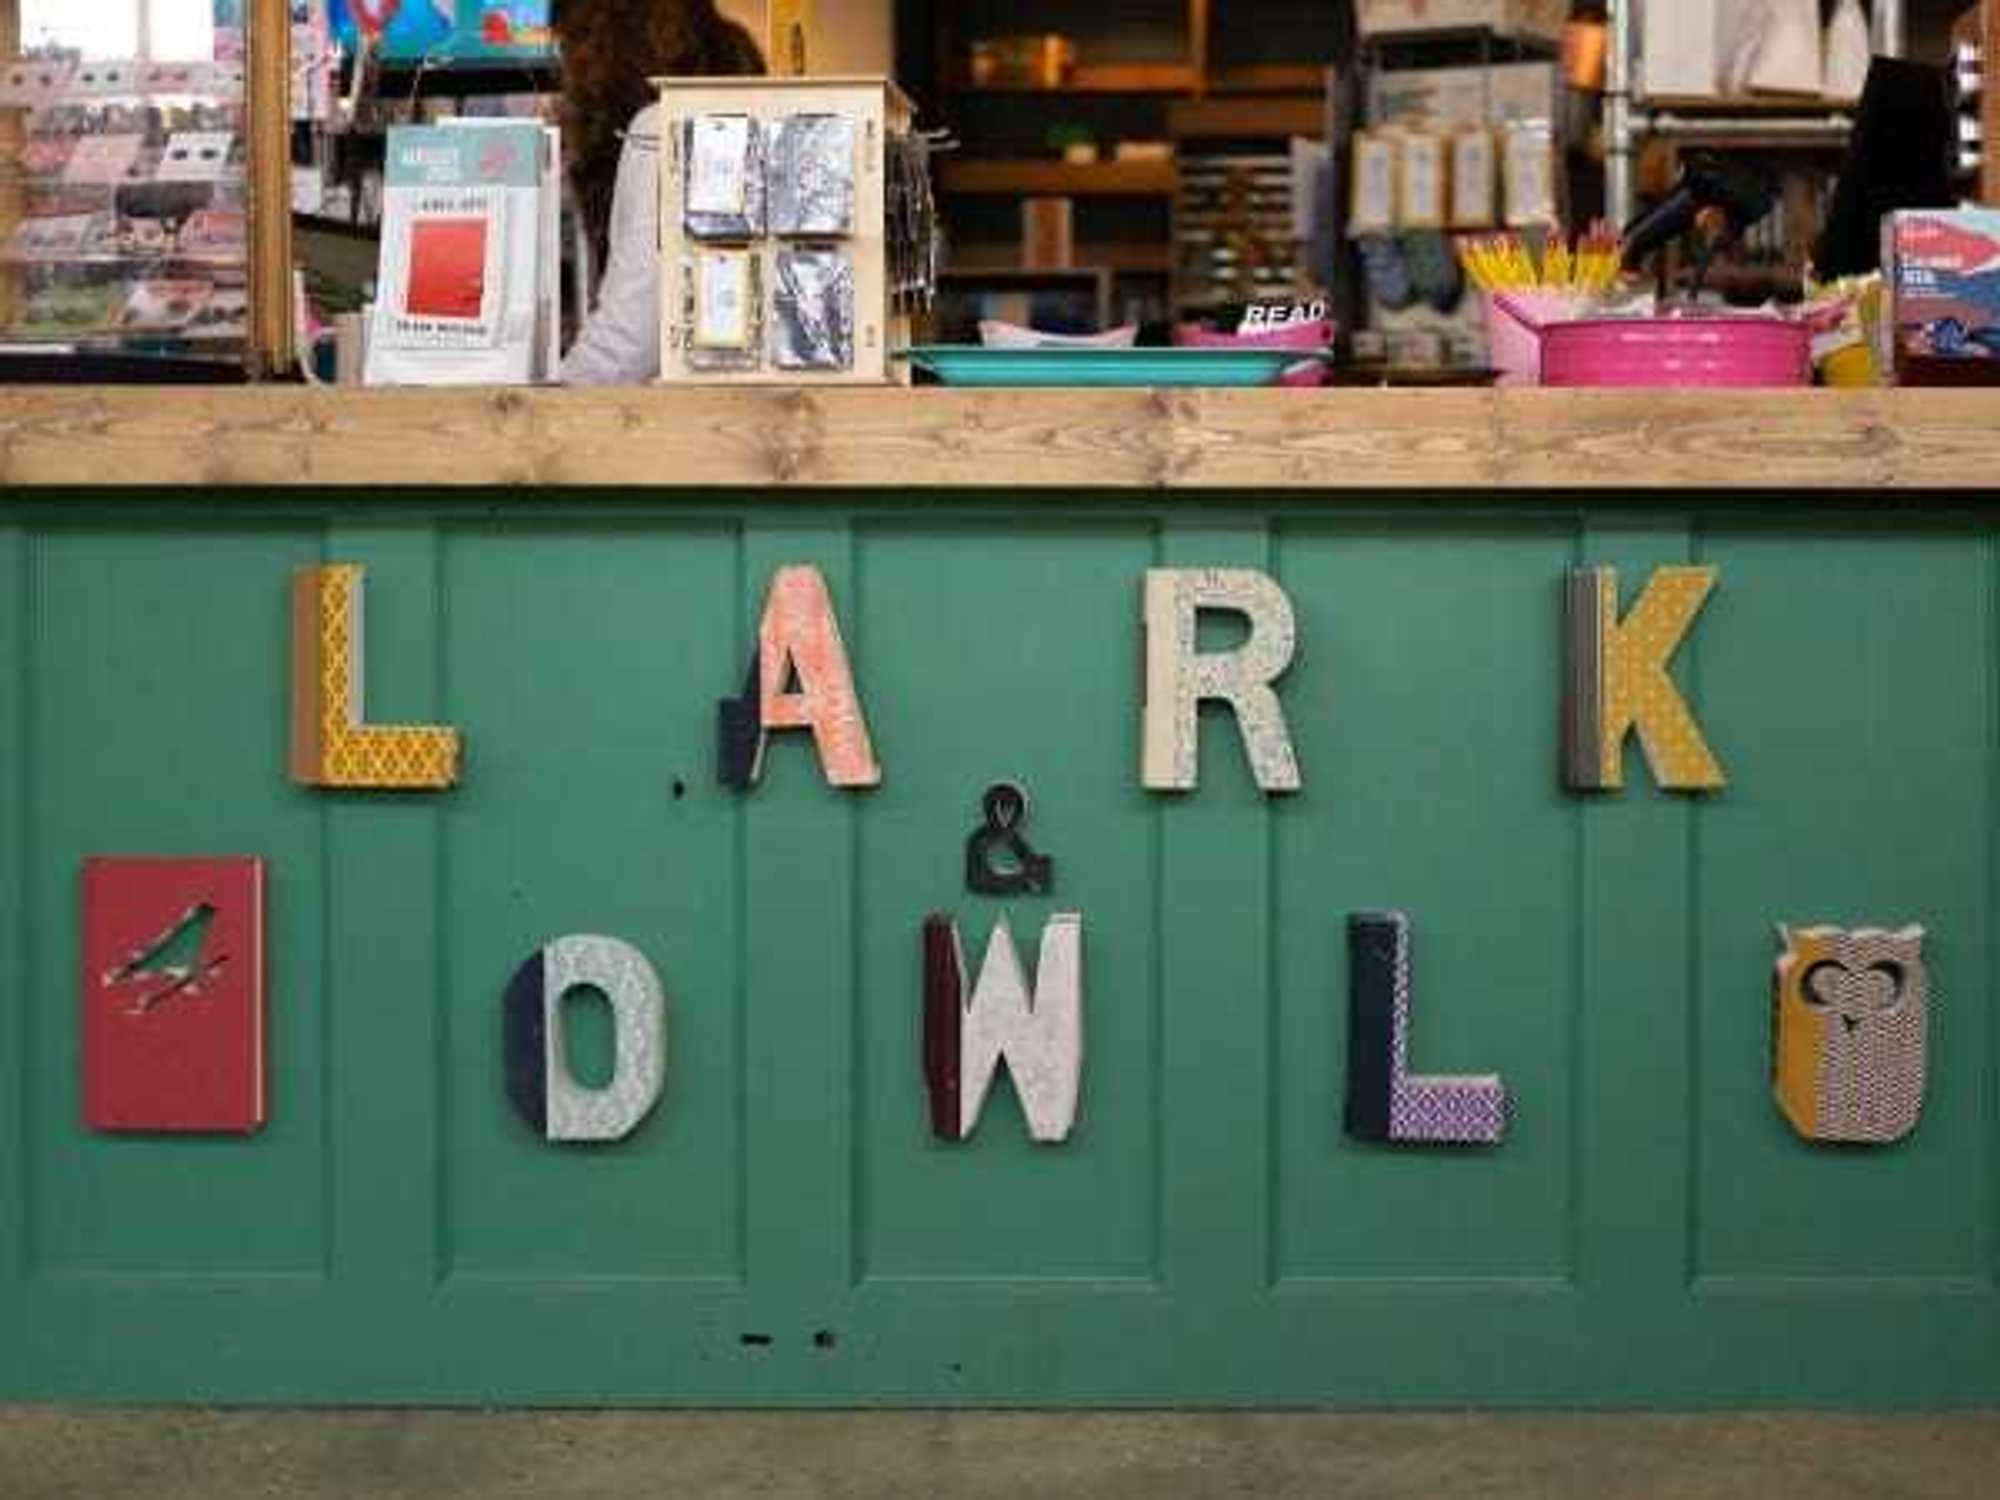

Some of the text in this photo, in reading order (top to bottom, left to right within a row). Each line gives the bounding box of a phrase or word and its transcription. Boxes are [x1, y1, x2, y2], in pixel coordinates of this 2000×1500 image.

[288, 563, 1725, 793] LARK
[964, 783, 1055, 897] &
[502, 911, 1512, 1143] OWL
